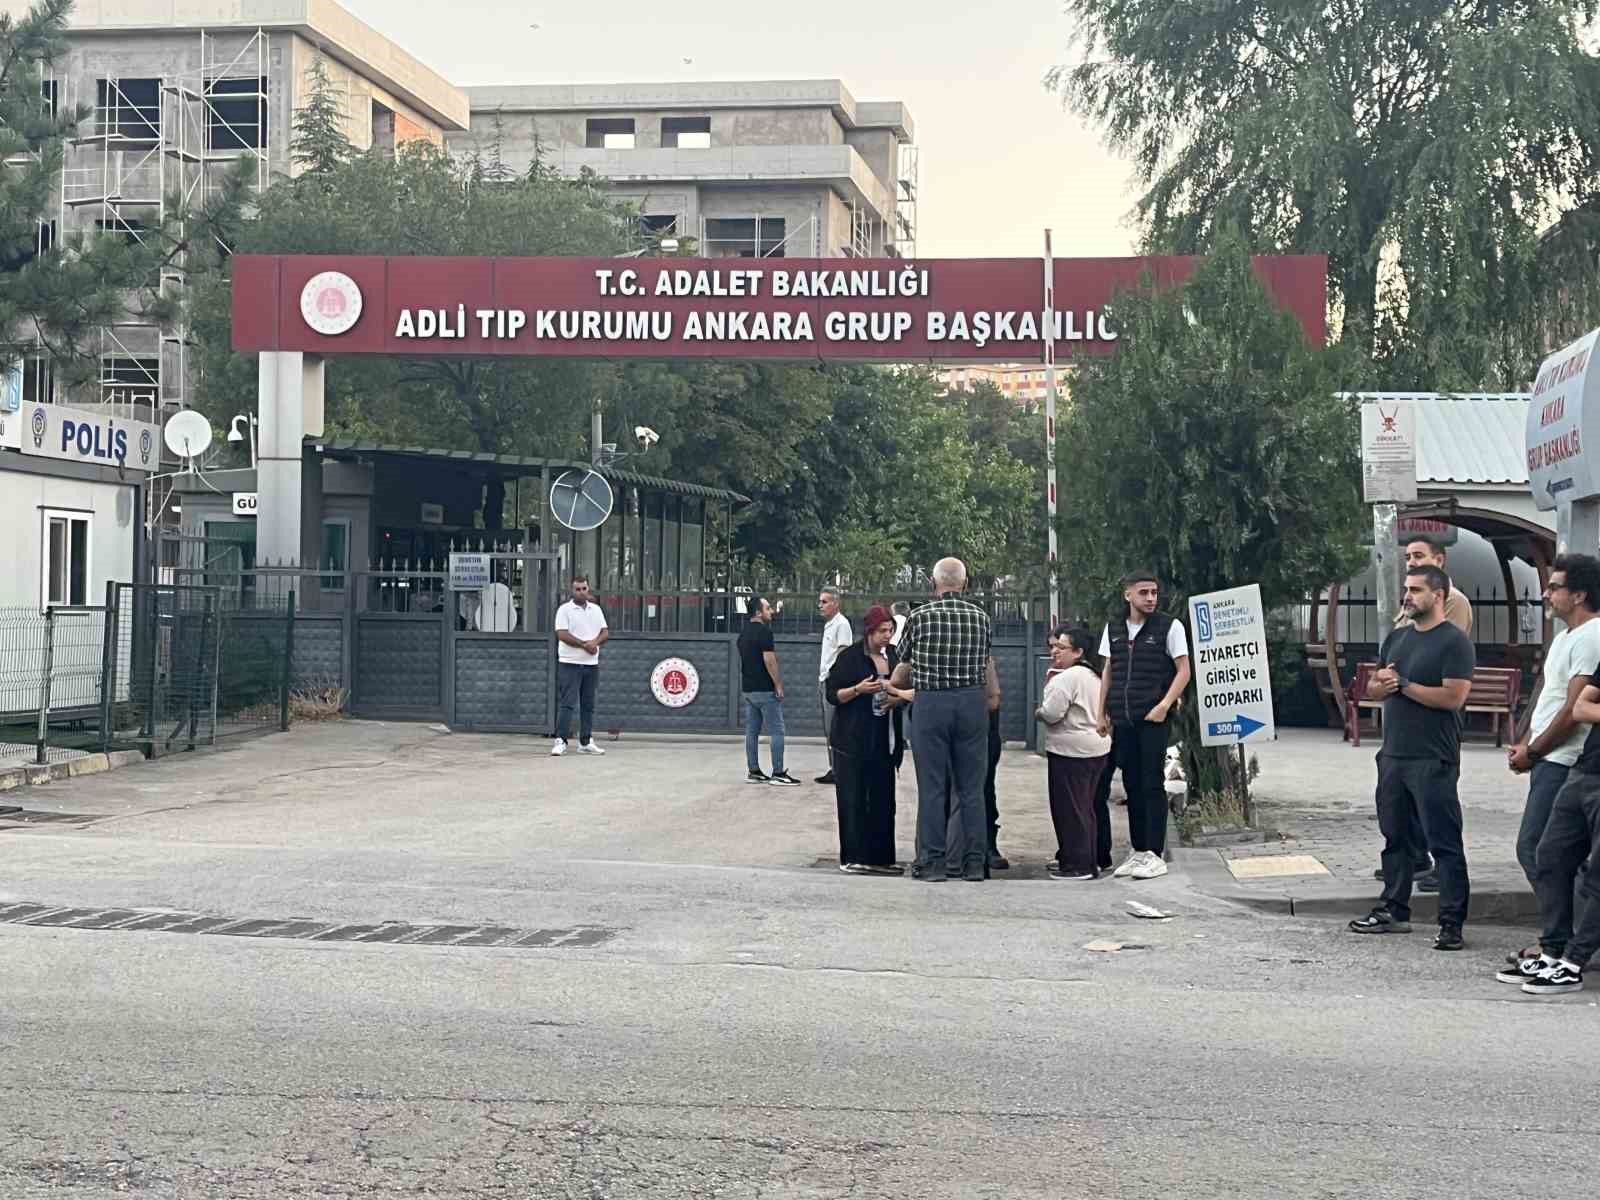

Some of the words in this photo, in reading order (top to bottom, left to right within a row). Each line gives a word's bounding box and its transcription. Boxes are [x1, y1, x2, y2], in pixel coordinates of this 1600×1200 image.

[595, 269, 646, 296] T.C.
[654, 269, 764, 296] ADALET
[772, 265, 929, 297] BAKANLIĞI
[394, 303, 466, 338] ADLİ
[475, 309, 526, 339] TIP
[536, 309, 673, 340] KURUMU
[682, 311, 814, 341] ANKARA
[824, 311, 912, 341] GRUP
[927, 304, 1119, 348] BAŞKANLI
[1206, 664, 1240, 686] GİRİŞİ
[1242, 668, 1257, 680] ve
[1204, 688, 1263, 708] OTOPARKI
[1233, 724, 1242, 733] m
